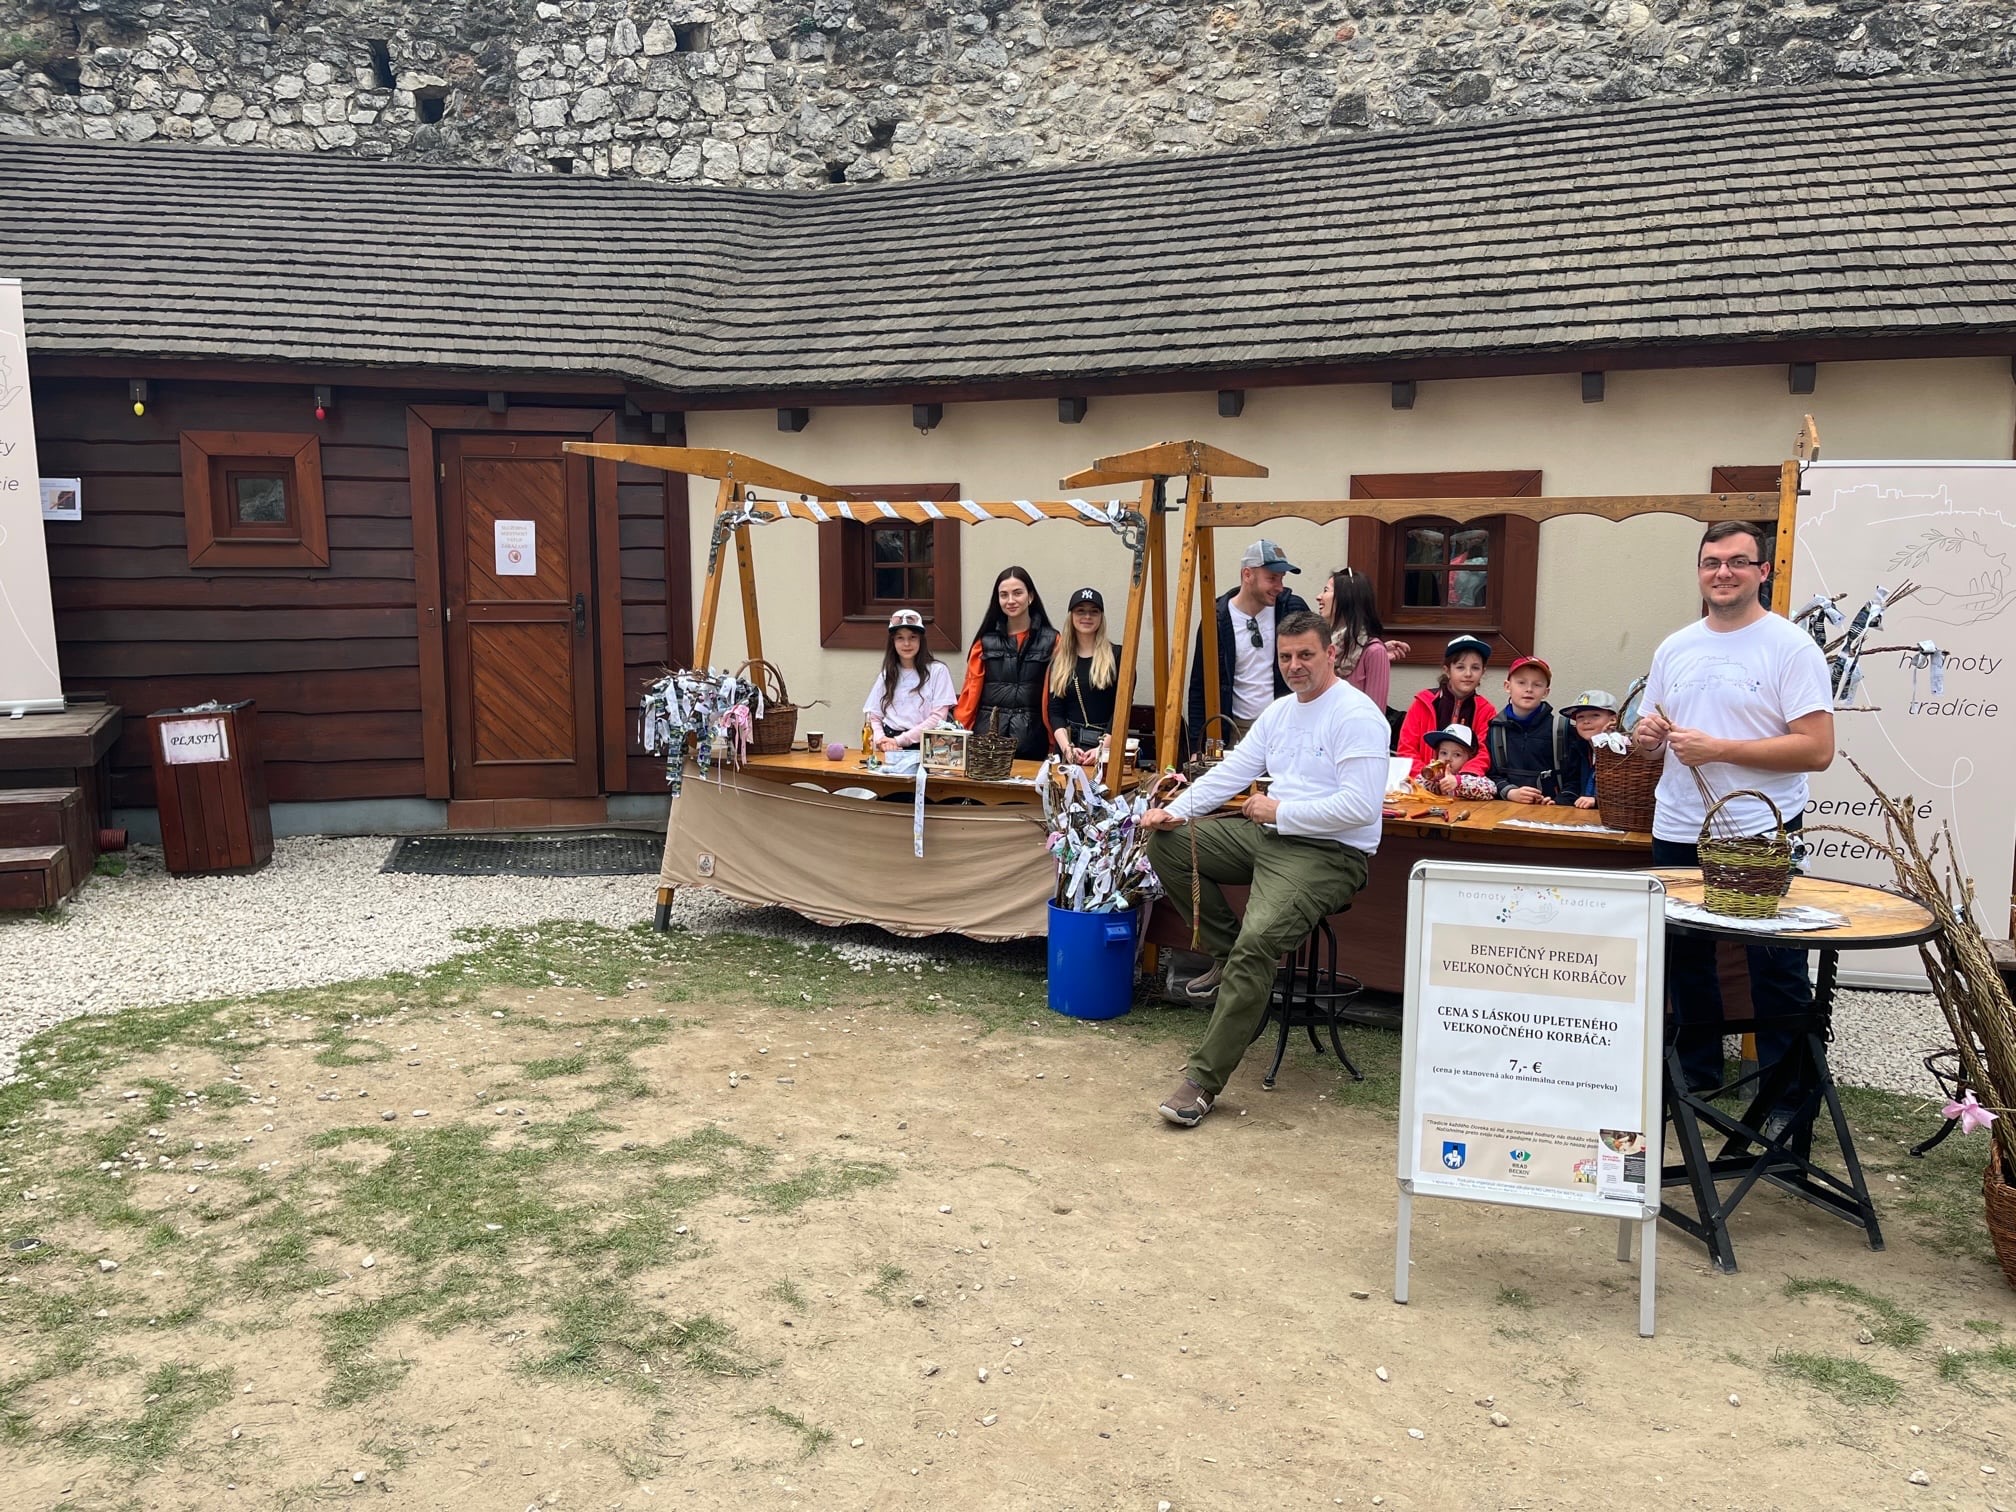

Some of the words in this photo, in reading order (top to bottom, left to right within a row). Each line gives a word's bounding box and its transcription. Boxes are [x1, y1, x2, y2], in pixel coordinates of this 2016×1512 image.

[1899, 651, 2002, 675] honoty
[1908, 699, 1998, 717] tradície
[170, 733, 219, 746] PLASTY
[1458, 889, 1507, 902] hodnoty
[1560, 897, 1607, 909] tradície
[1470, 944, 1545, 961] BENEFIČNÝ
[1549, 950, 1598, 967] PREDAJ
[1443, 960, 1549, 980] VEĽKONOČNÝCH
[1553, 969, 1627, 987] KORBÁČOV
[1437, 1006, 1469, 1019] CENA
[1472, 1009, 1479, 1019] S
[1481, 1008, 1530, 1023] LÁSKOU
[1533, 1014, 1618, 1032] UPLETENÉHO
[1443, 1021, 1543, 1040] VEĽKONOČNÉHO
[1546, 1030, 1611, 1047] KORBÁČA:
[1432, 1066, 1453, 1075] (cena
[1453, 1069, 1461, 1077] je
[1462, 1069, 1499, 1079] stanovená
[1515, 1074, 1556, 1085] minimálna
[1557, 1079, 1575, 1087] cena
[1509, 1059, 1528, 1074] 7,-
[1532, 1061, 1542, 1074] €
